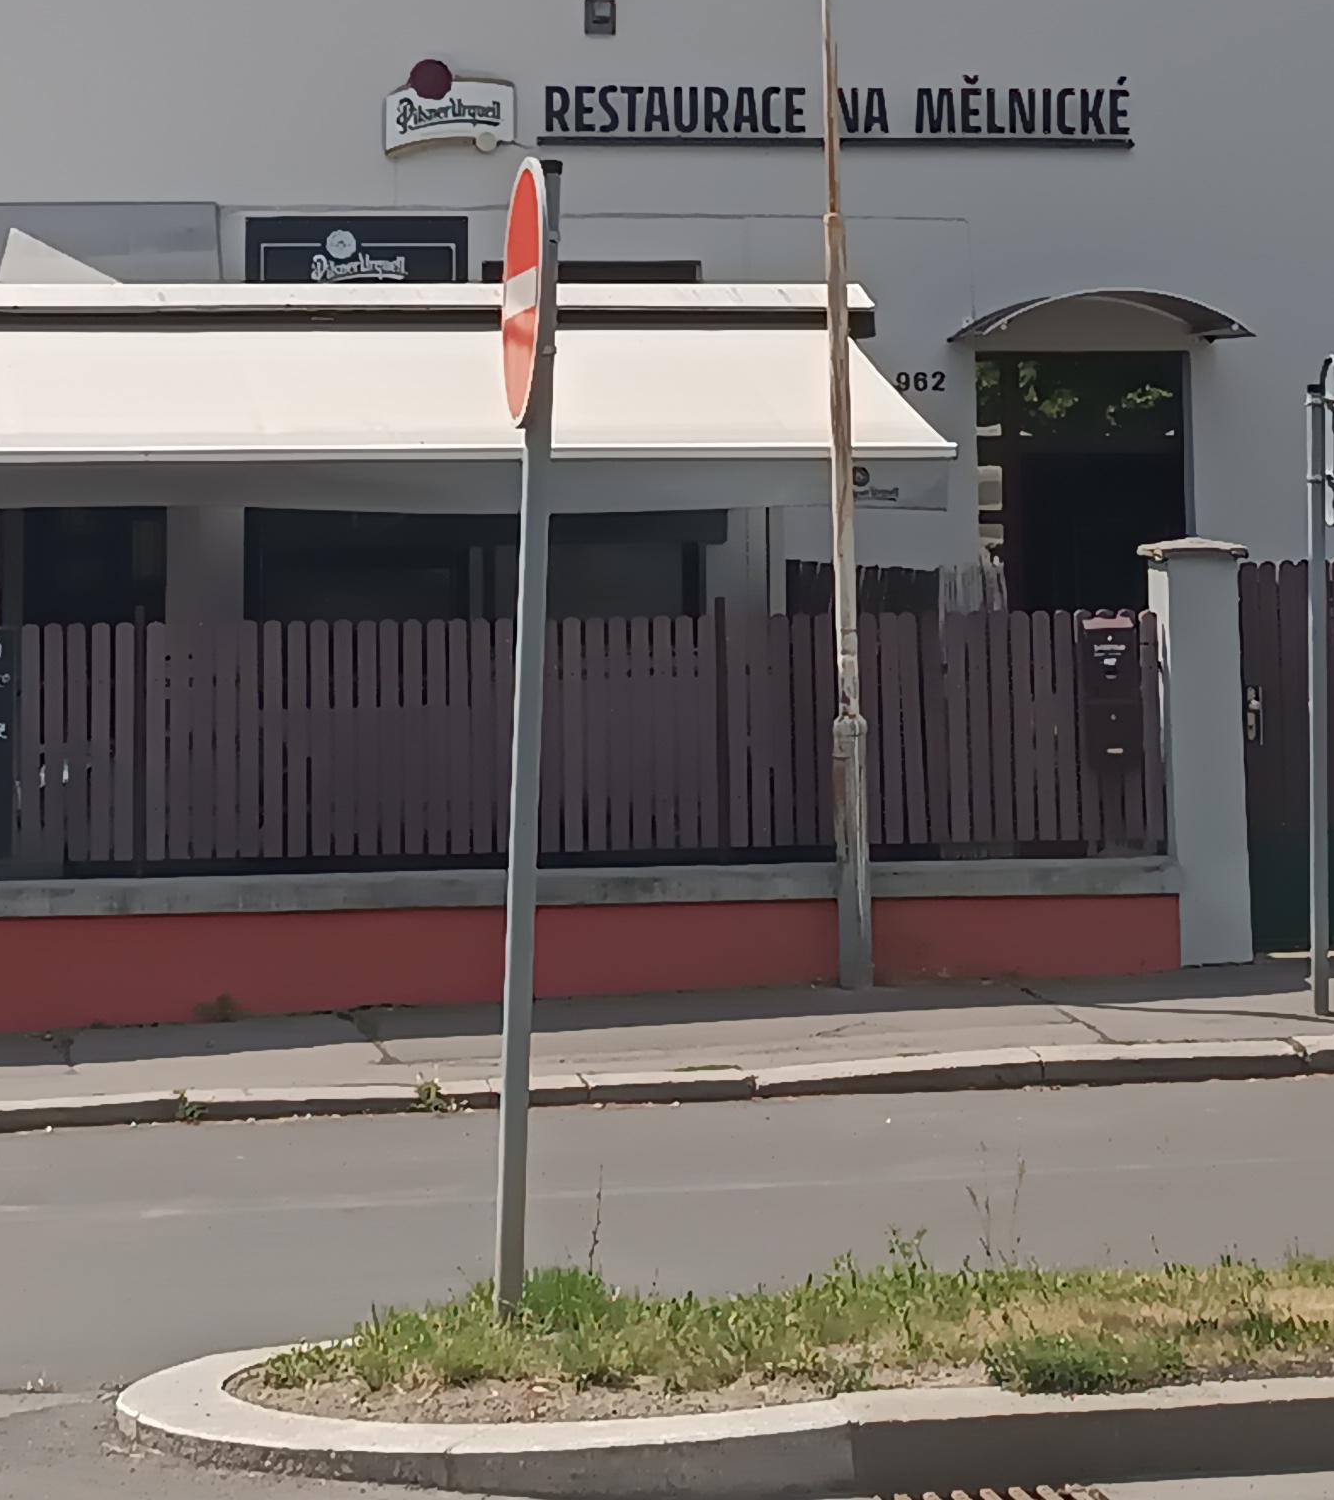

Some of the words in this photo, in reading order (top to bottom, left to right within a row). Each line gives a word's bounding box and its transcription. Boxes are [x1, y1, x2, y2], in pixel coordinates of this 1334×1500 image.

[545, 85, 805, 133] RESTAURACE
[917, 76, 1131, 135] MĚLNICKÉ
[895, 371, 946, 392] 962
